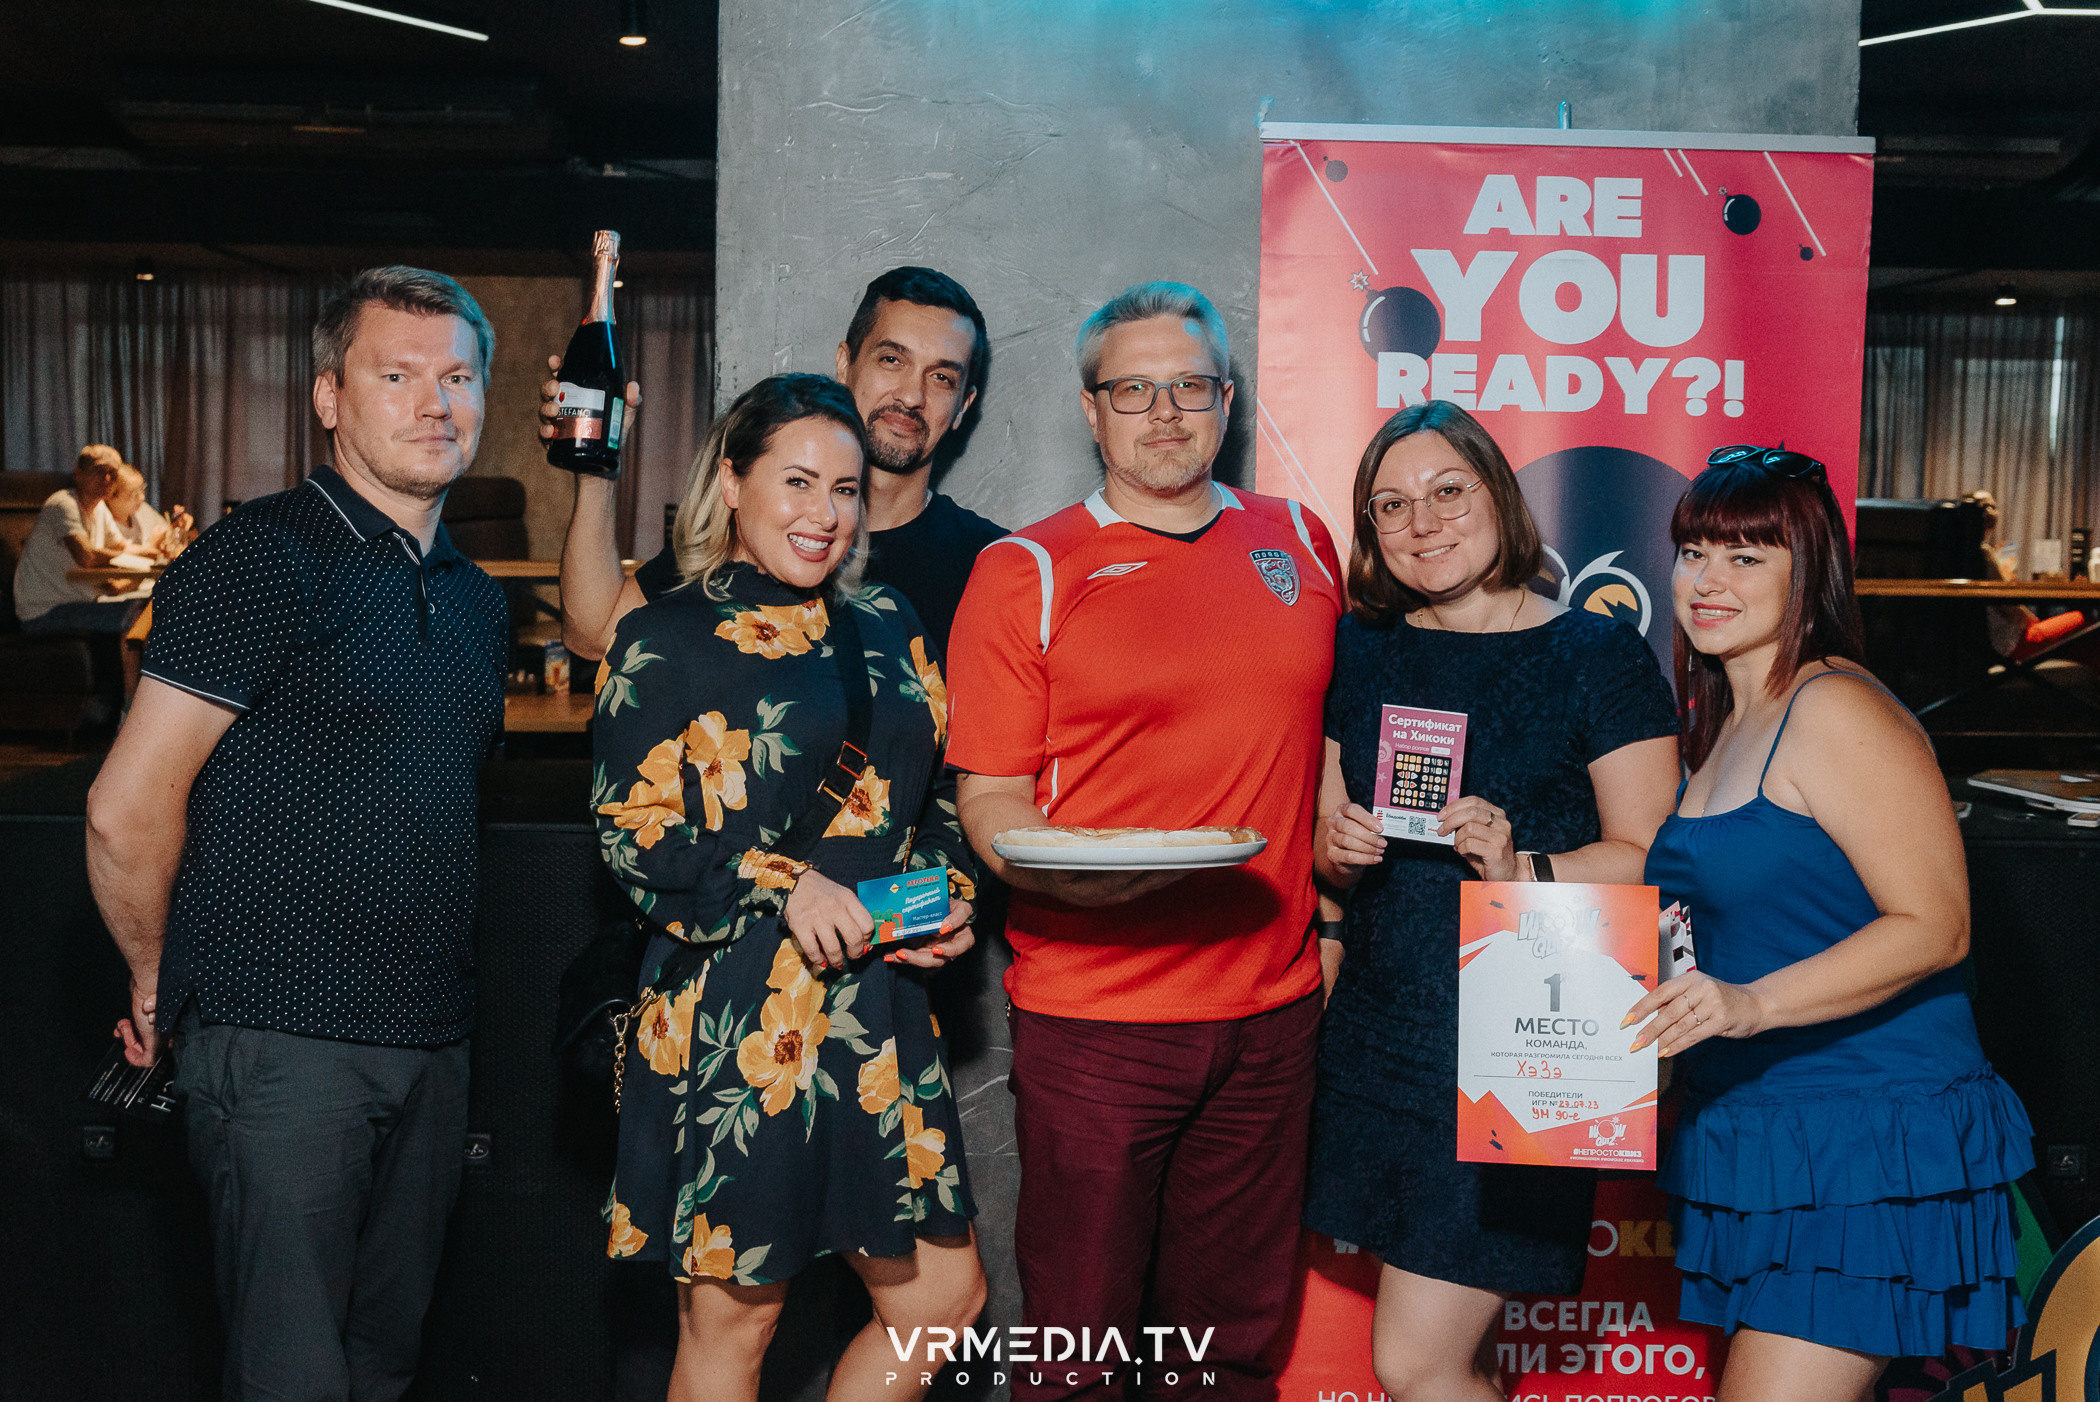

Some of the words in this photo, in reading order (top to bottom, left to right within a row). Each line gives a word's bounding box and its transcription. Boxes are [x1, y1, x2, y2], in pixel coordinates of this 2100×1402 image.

[1463, 174, 1643, 238] ARE
[1411, 249, 1706, 347] YOU
[1376, 352, 1745, 418] READY?!
[1388, 713, 1463, 733] Сертификат
[1393, 729, 1408, 740] на
[1410, 729, 1455, 746] Хикоки
[1543, 973, 1561, 1013] 1
[1514, 1017, 1600, 1037] МЕСТО
[1528, 1090, 1583, 1099] ПОБЕДИТЕЛИ
[1573, 1148, 1642, 1158] #НЕПРОСТОКВИЗ
[1504, 1301, 1655, 1337] ВСЕГДА
[1559, 1343, 1706, 1380] ЭТОГО,
